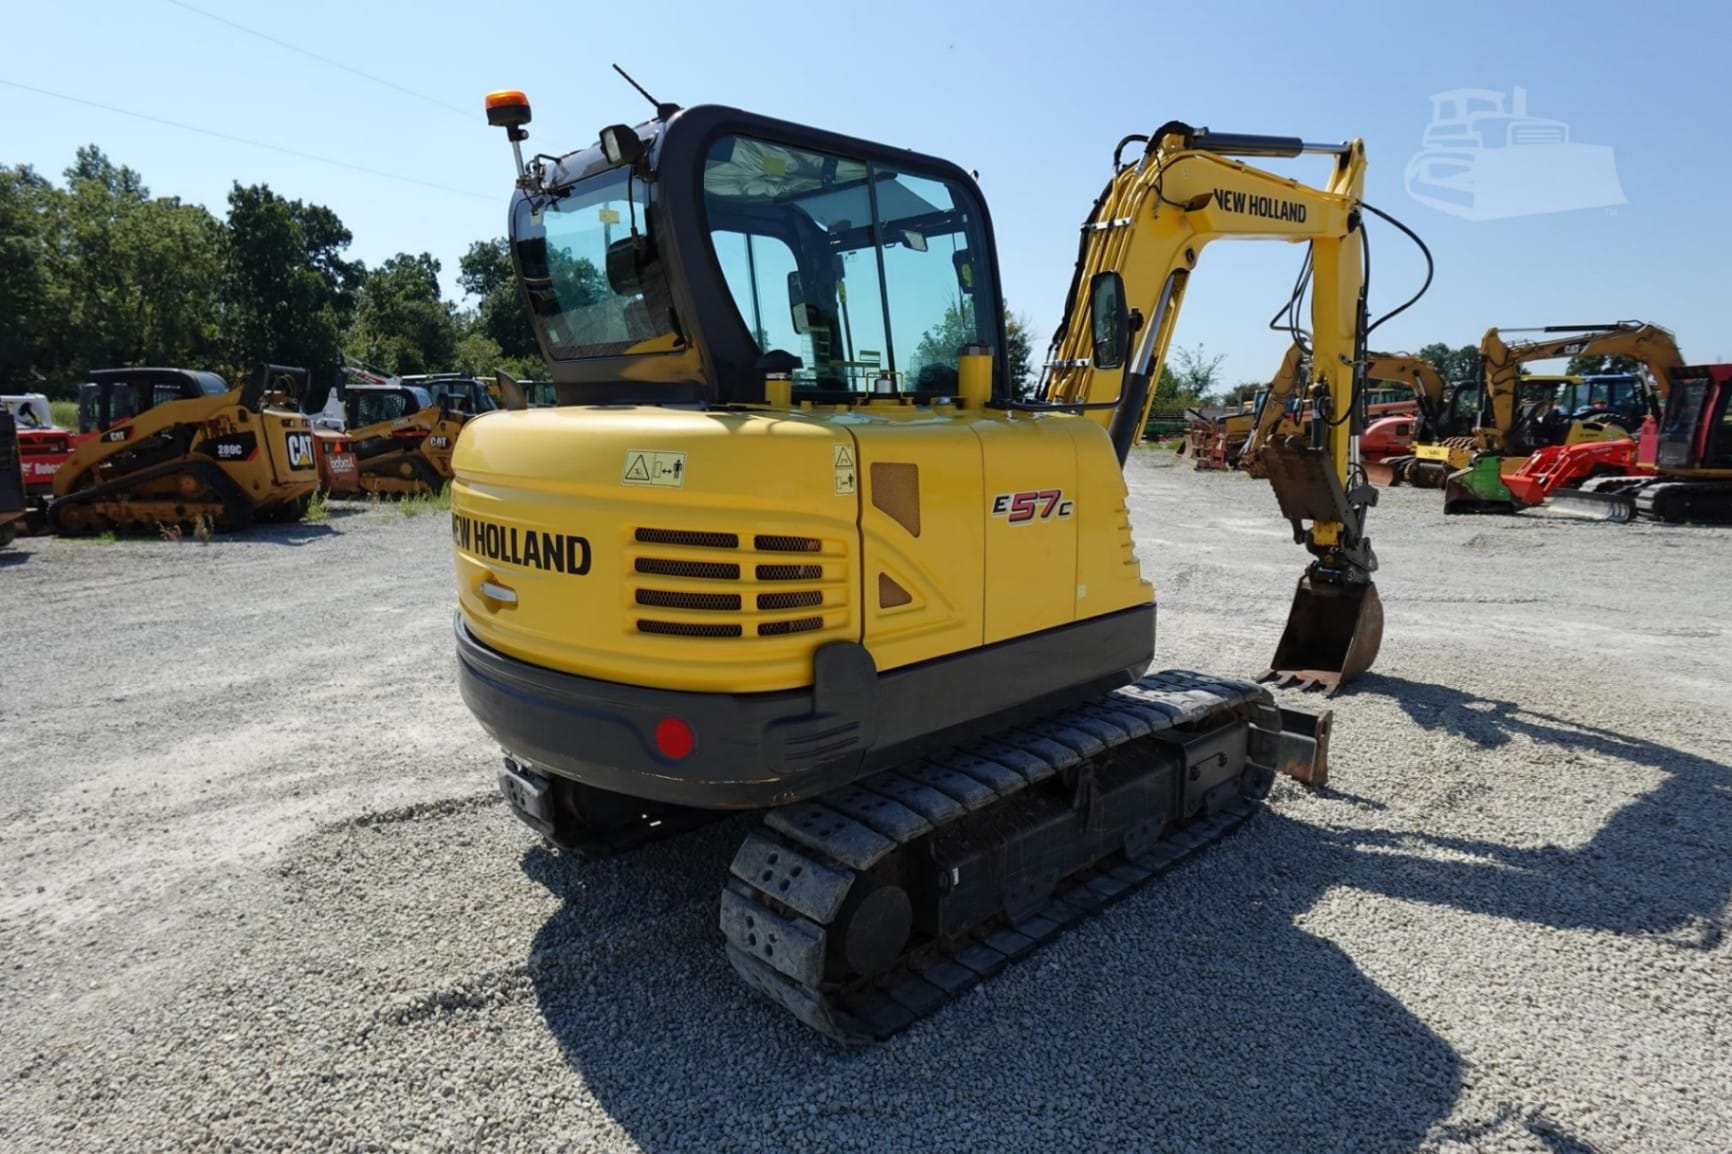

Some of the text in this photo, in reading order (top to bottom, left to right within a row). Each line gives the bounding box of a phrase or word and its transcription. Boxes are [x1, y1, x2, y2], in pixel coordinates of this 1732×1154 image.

[1213, 188, 1307, 223] NEW HOLLAND
[110, 431, 125, 441] CAT
[287, 435, 313, 466] CAT
[430, 437, 447, 447] CAT
[473, 519, 592, 576] HOLLAND
